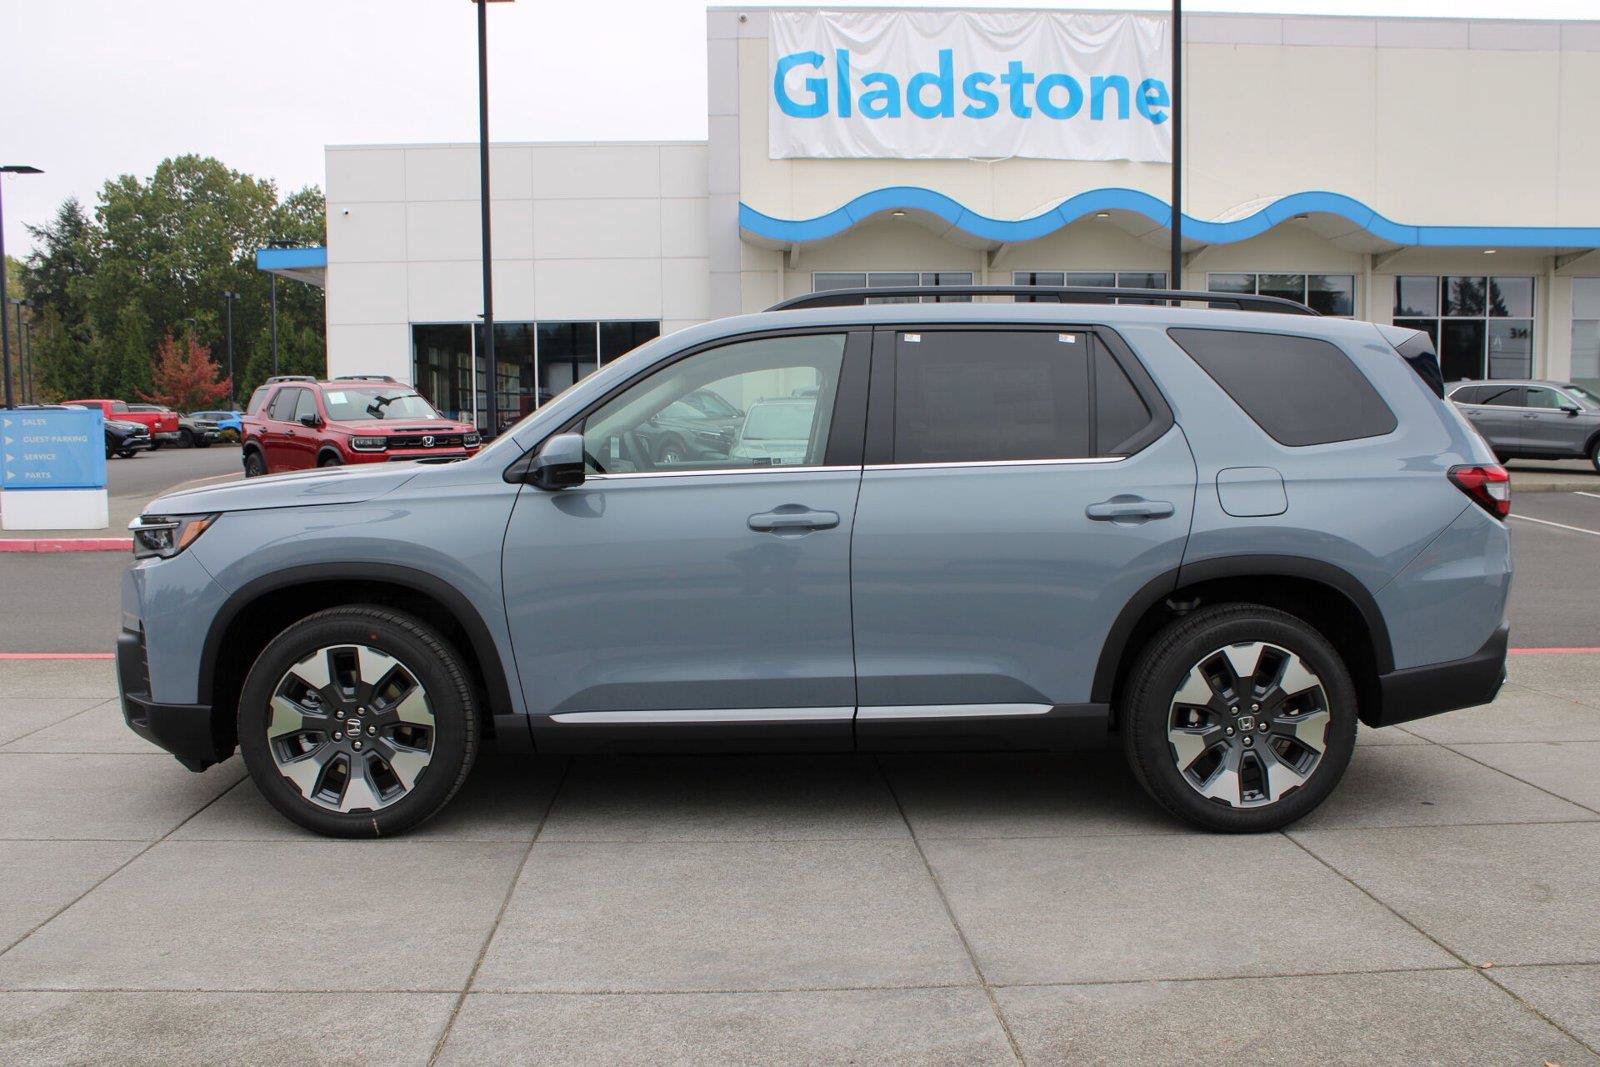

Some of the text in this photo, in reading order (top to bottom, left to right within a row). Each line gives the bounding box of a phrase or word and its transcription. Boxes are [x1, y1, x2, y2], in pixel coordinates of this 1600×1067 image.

[773, 48, 1171, 125] Gladstone
[22, 418, 47, 426] SALES
[23, 435, 88, 443] GUEST PARKING
[23, 453, 57, 461] SERVICE
[26, 471, 51, 480] PARTS
